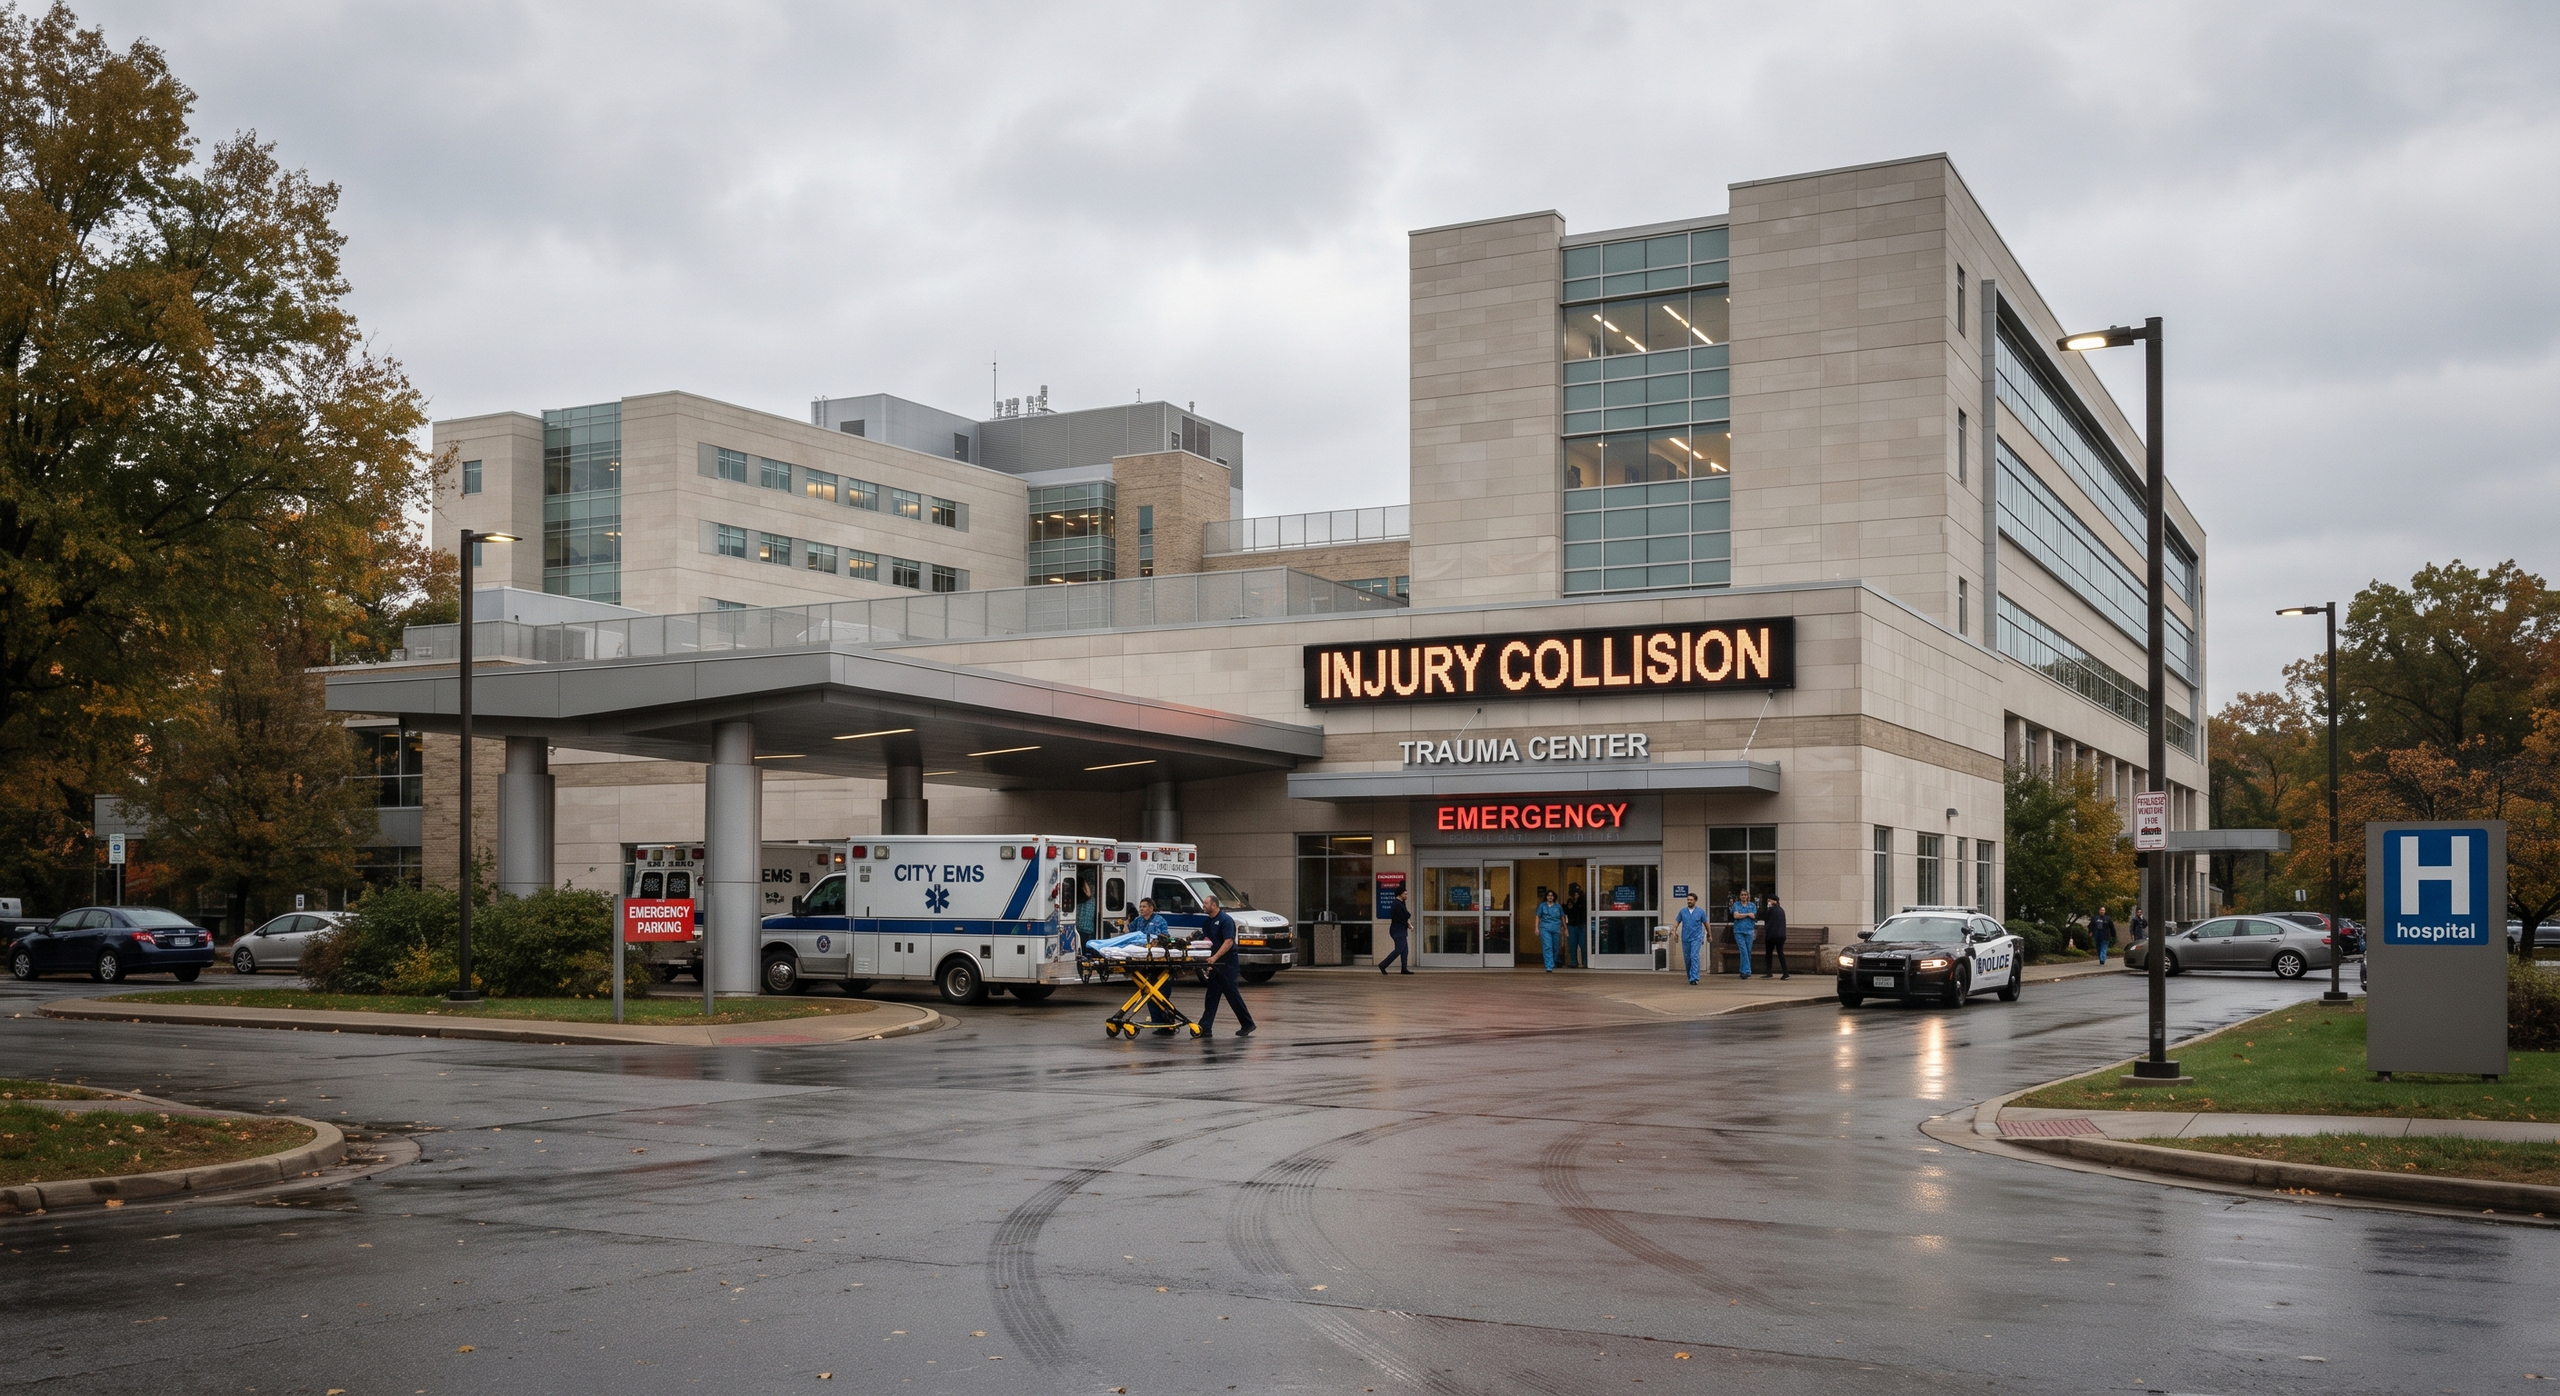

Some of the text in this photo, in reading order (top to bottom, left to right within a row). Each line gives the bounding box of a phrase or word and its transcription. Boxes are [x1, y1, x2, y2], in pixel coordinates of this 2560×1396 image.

[1319, 627, 1770, 699] INJURY COLLISION
[1399, 733, 1649, 765] TRAUMA CENTER
[1438, 803, 1627, 830] EMERGENCY
[762, 868, 793, 883] EMS
[894, 864, 985, 883] CITY EMS
[2400, 835, 2470, 915] H
[629, 906, 690, 919] EMERGENCY
[637, 921, 682, 934] PARKING
[2397, 922, 2476, 942] hospital
